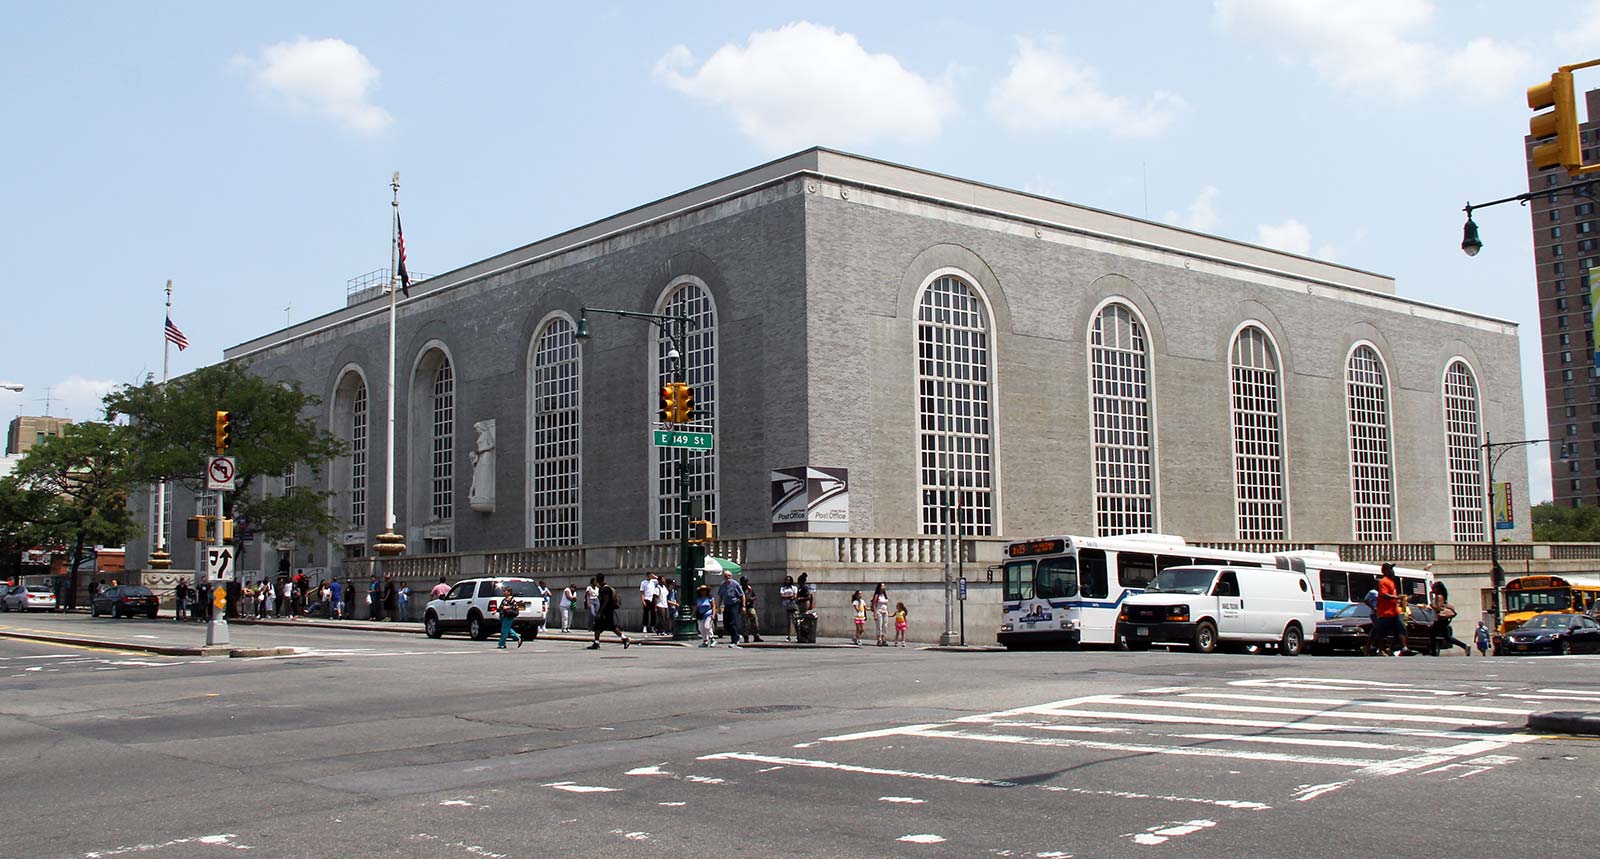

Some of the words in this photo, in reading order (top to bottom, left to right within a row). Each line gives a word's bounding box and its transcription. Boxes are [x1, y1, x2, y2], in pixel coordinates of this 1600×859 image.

[661, 434, 668, 443] E
[673, 435, 689, 444] 149
[693, 436, 705, 445] St
[790, 512, 805, 520] Office
[815, 512, 828, 520] Post
[829, 512, 846, 520] Office
